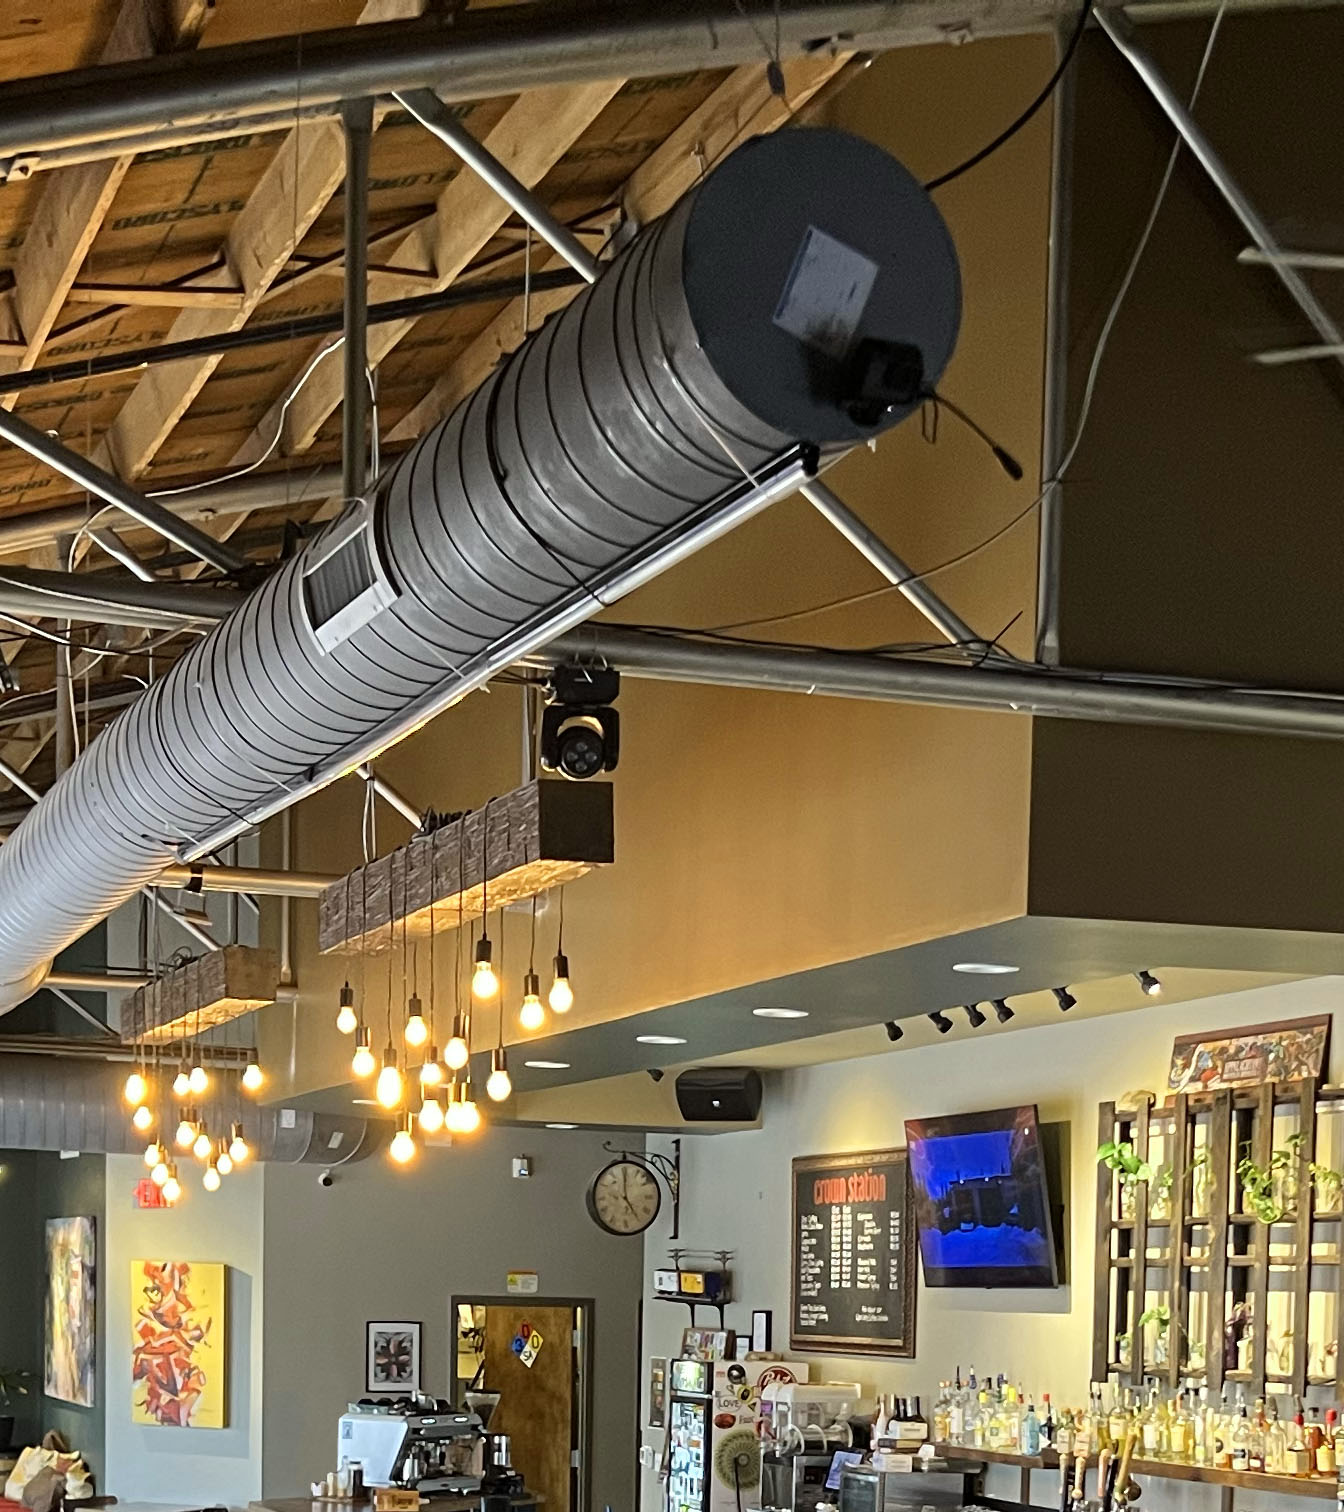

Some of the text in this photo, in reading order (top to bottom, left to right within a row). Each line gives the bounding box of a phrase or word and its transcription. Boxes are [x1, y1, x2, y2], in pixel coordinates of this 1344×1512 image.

[847, 1167, 887, 1203] station
[531, 1335, 539, 1349] 0
[719, 1399, 740, 1408] LOVE
